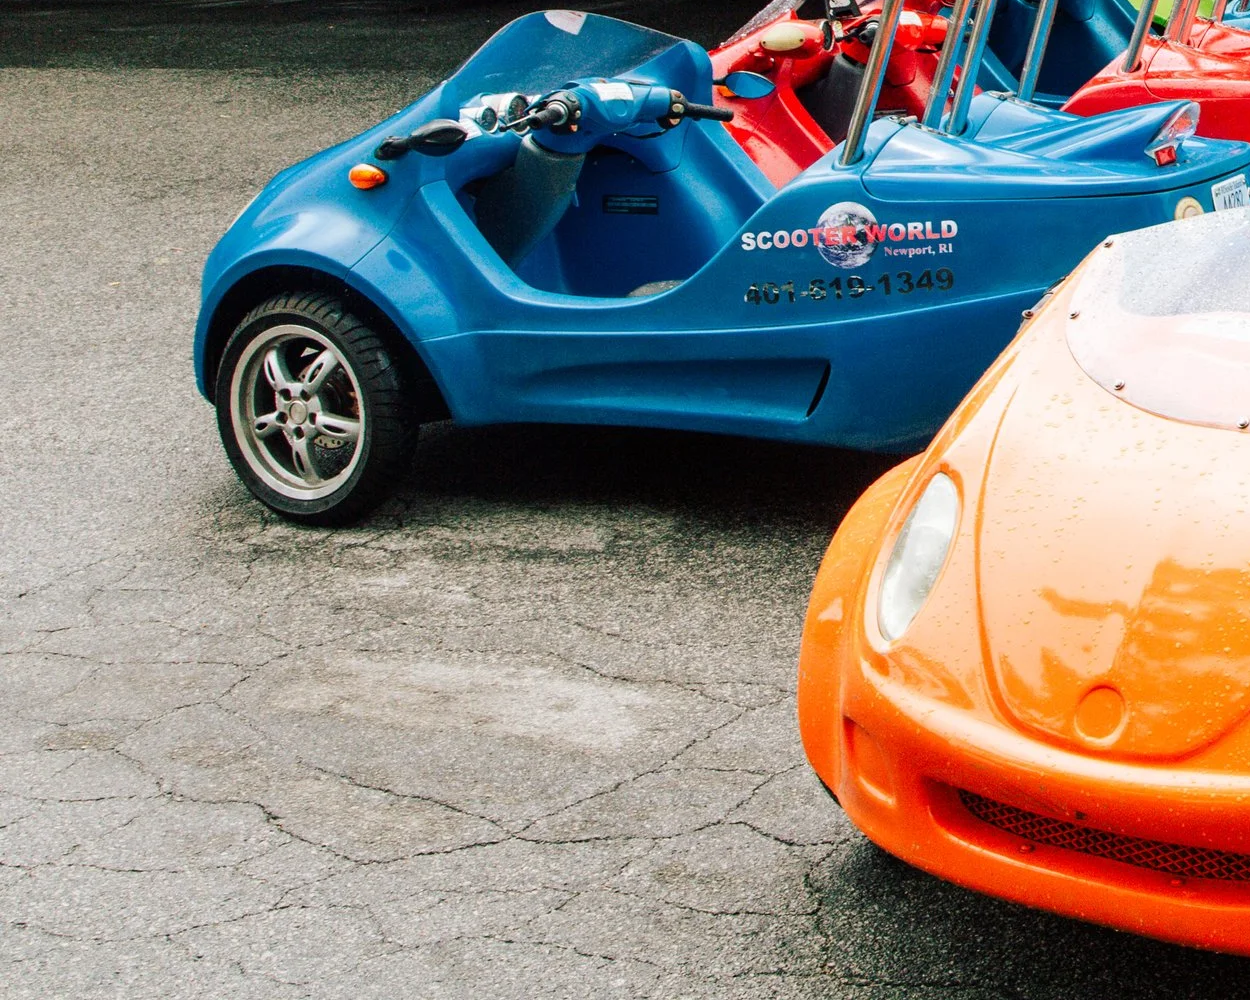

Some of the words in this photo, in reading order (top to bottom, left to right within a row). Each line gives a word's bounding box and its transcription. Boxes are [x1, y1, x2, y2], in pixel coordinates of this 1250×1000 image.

[742, 225, 857, 251] SCOOTER
[865, 220, 958, 244] WORLD
[884, 245, 936, 258] Newport,
[939, 243, 953, 254] RI
[744, 267, 954, 305] 401-619-1349
